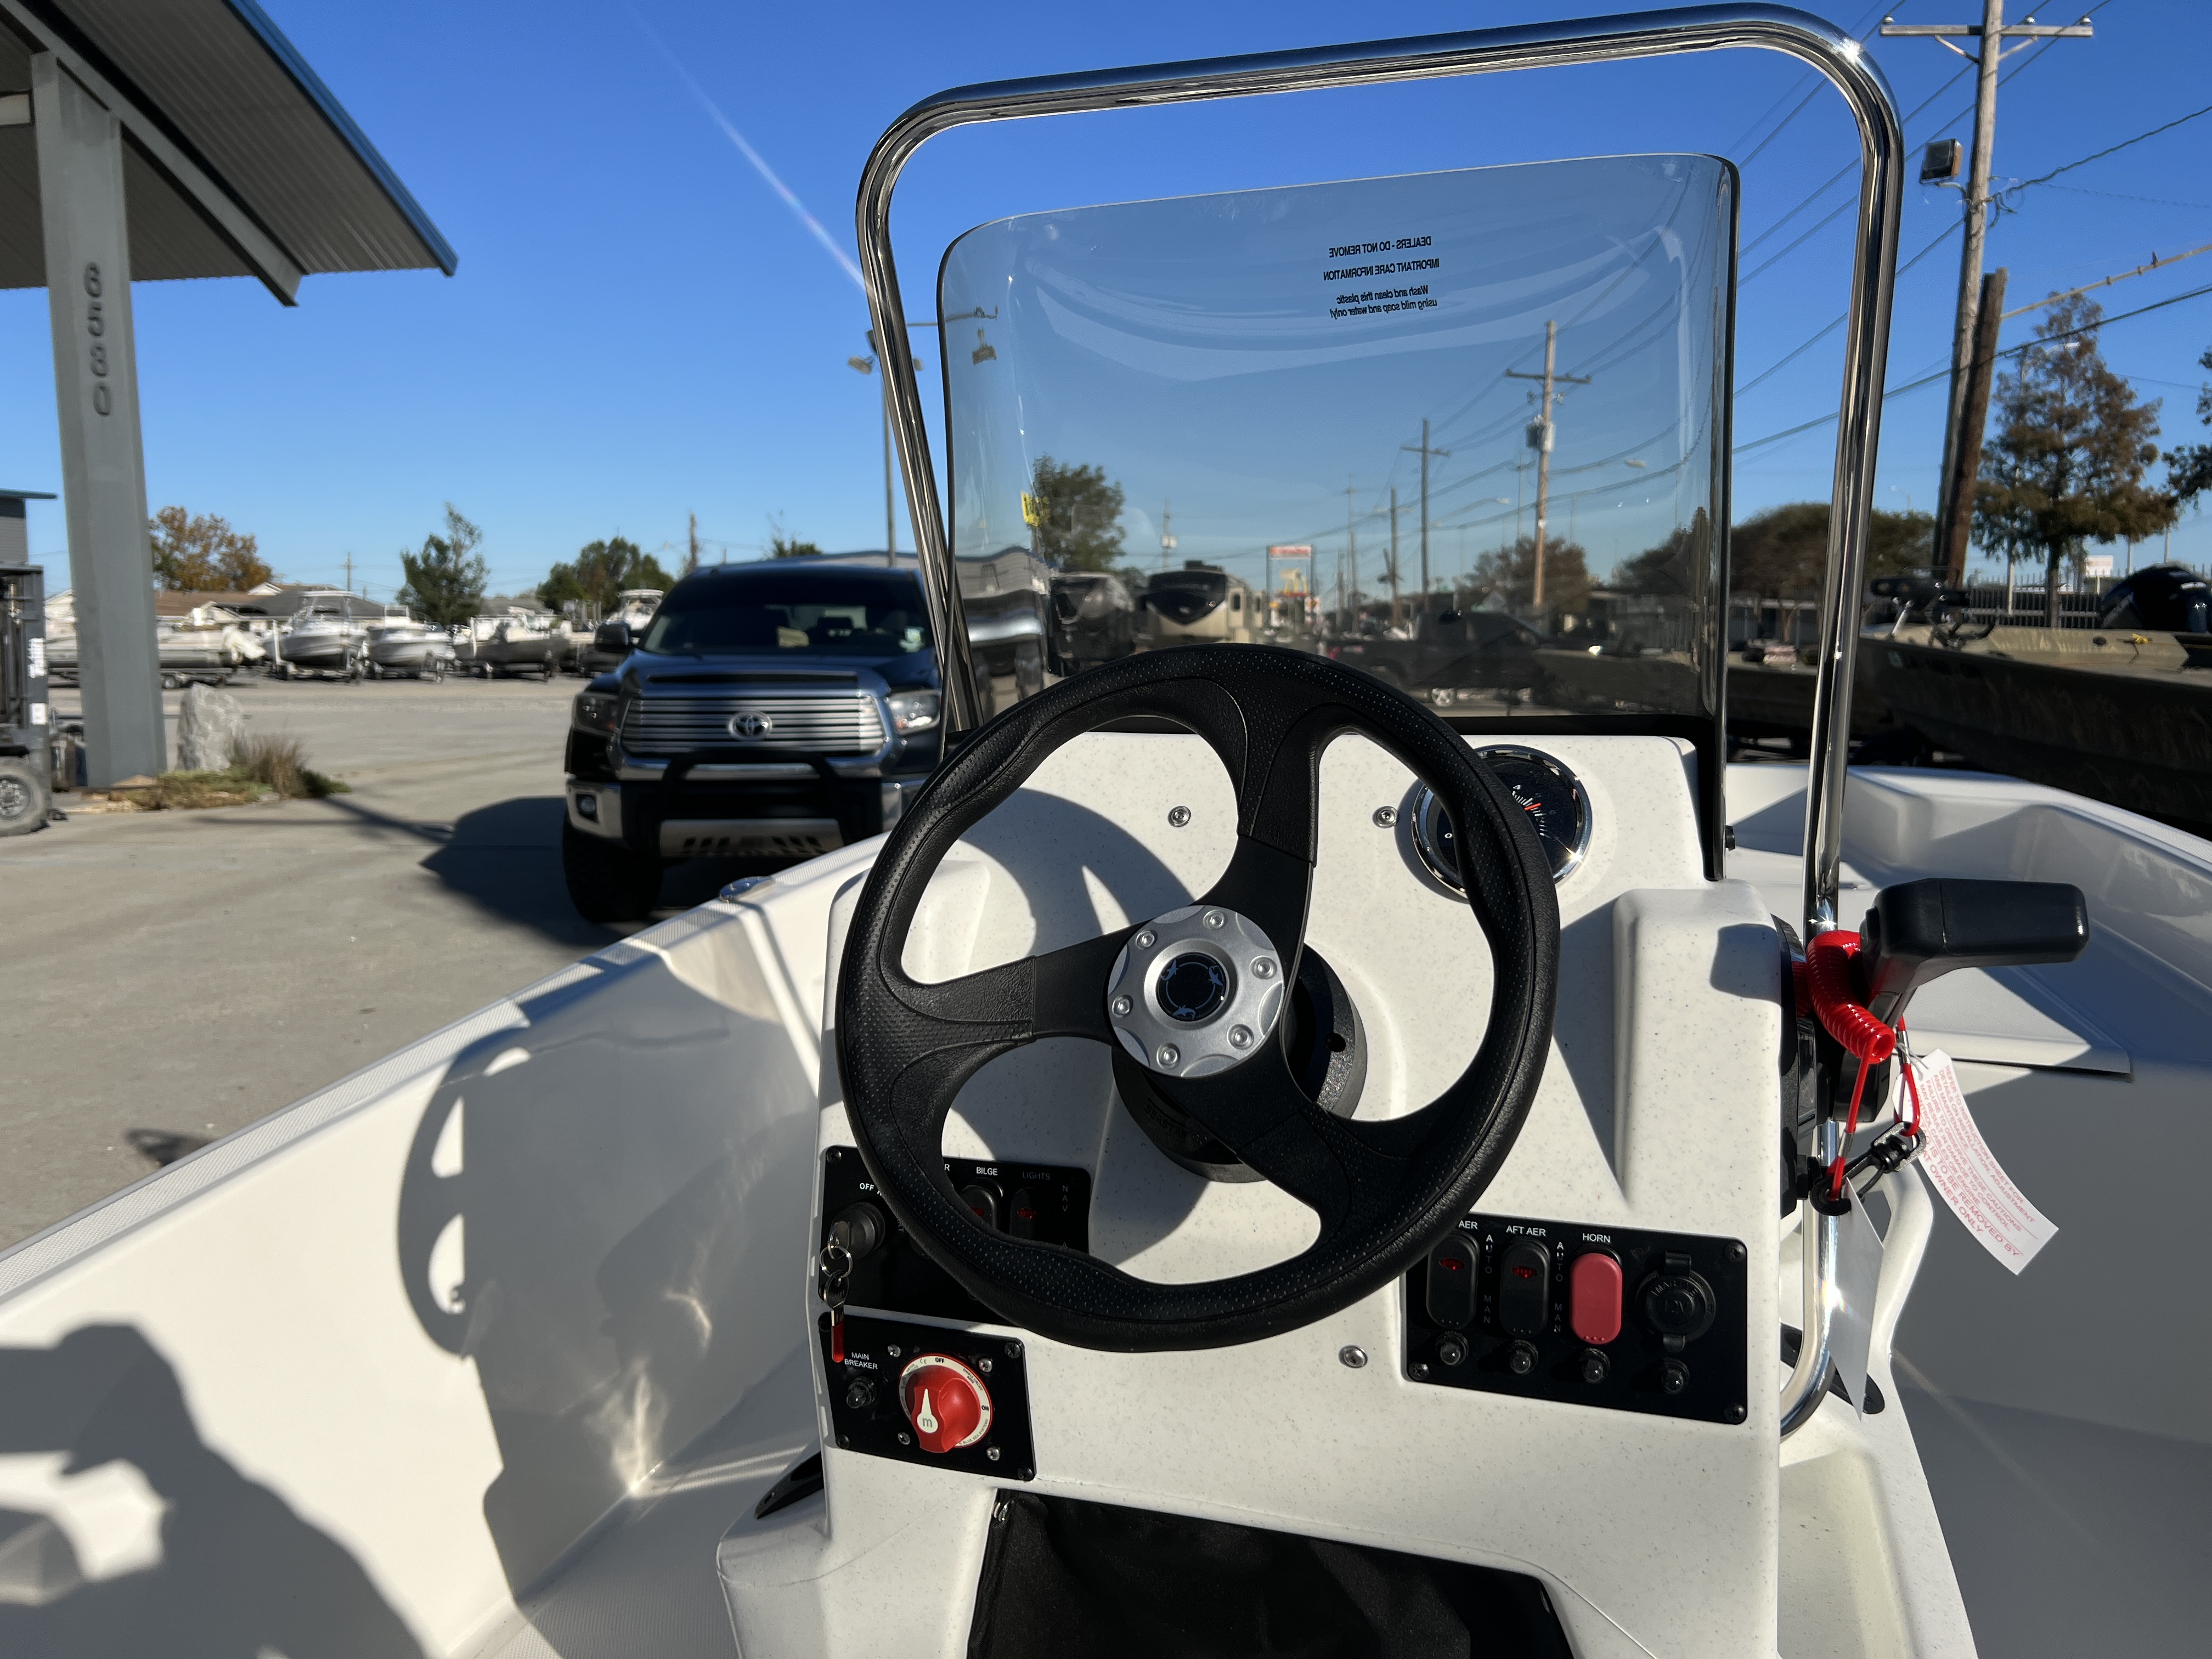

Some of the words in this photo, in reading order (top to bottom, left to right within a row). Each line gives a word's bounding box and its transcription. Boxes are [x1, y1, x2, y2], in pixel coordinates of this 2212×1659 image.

[1934, 1075, 1942, 1091] AND
[1921, 1084, 1929, 1101] MAY
[1927, 1102, 1944, 1133] RESULT
[1941, 1135, 1948, 1144] IN
[1946, 1144, 1970, 1179] DAMAGE
[1969, 1180, 1978, 1191] TO
[1926, 1079, 1941, 1113] FAILURE
[1939, 1114, 1946, 1126] TO
[1945, 1127, 1968, 1166] OBSERVE
[1967, 1166, 1987, 1193] THESE
[1939, 1069, 1954, 1103] DETAILS
[1951, 1103, 1959, 1116] ON
[1990, 1175, 2035, 1222] ADJUSTMENT
[1945, 1065, 1957, 1093] REFER
[1955, 1093, 1961, 1105] TO
[1960, 1106, 1990, 1160] INSTRUCTION
[1989, 1160, 2010, 1186] SHEET
[2008, 1187, 2024, 1204] FOR
[1931, 1128, 1950, 1161] CABLES
[1949, 1161, 1959, 1175] OR
[976, 1166, 998, 1176] BILGE
[1022, 1171, 1051, 1180] LIGHTS
[1929, 1164, 1959, 1206] OWNER
[859, 1182, 875, 1192] OFF
[1929, 1146, 1938, 1158] IS
[1937, 1158, 1948, 1174] TO
[1947, 1175, 1960, 1192] BE
[1959, 1192, 2004, 1243] REMOVED
[2004, 1243, 2020, 1256] BY
[1458, 1220, 1479, 1229] AER
[1506, 1225, 1524, 1234] AFT
[1526, 1227, 1547, 1237] AER
[1582, 1232, 1611, 1243] HORN
[1485, 1234, 1494, 1274] AUTO
[1556, 1242, 1565, 1282] AUTO
[1483, 1294, 1492, 1324] MAN
[1554, 1302, 1562, 1333] MAN
[844, 1358, 878, 1370] BREAKER
[851, 1351, 870, 1361] MAIN
